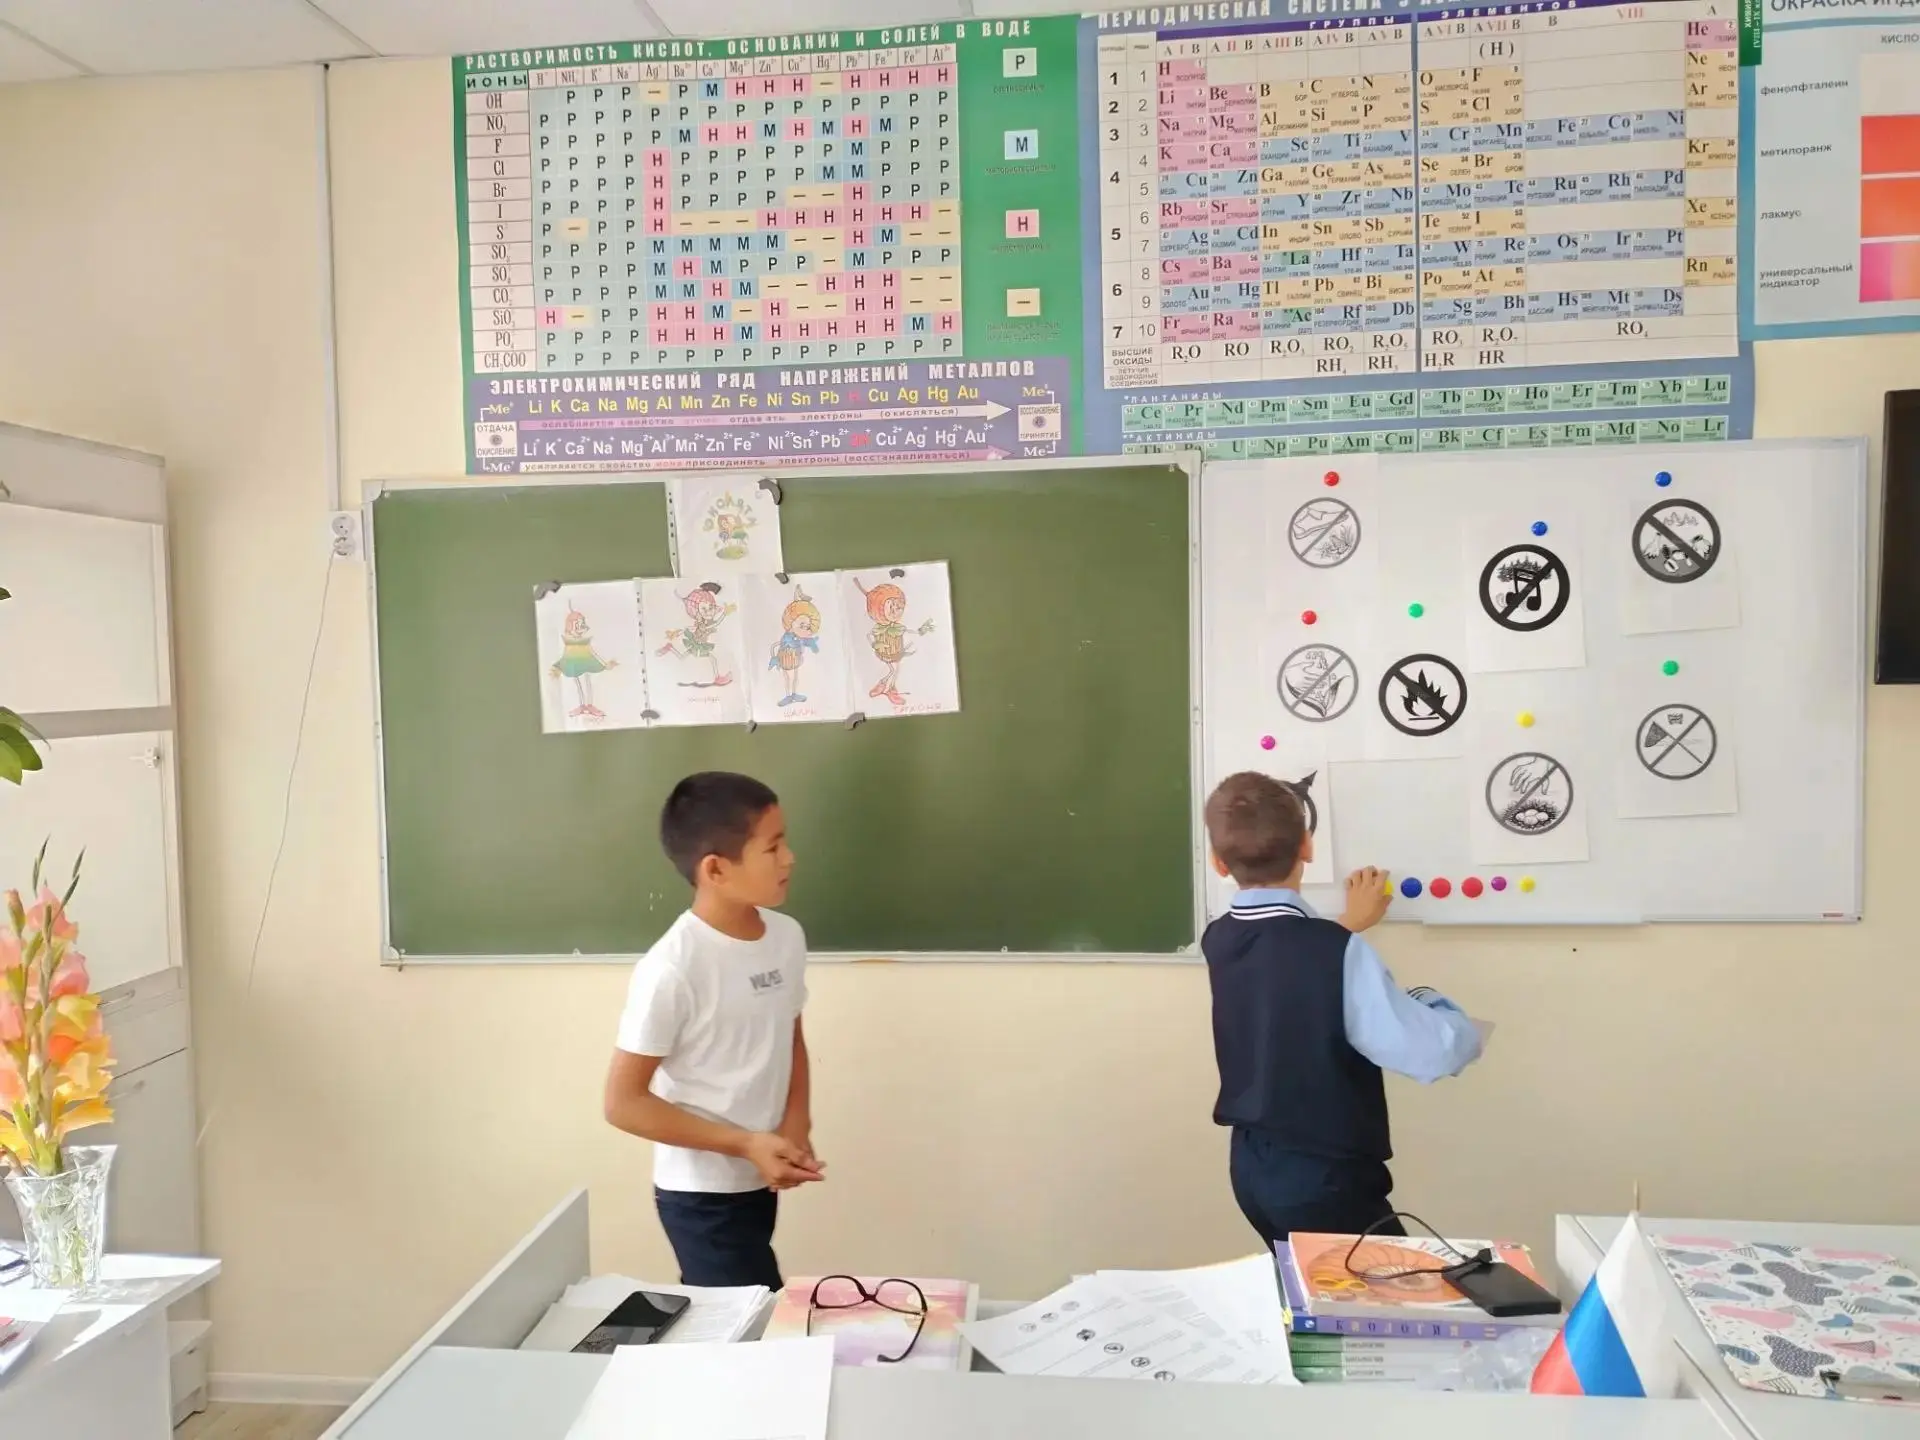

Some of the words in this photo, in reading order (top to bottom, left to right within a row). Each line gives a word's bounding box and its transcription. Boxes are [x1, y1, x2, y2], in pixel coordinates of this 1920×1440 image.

[1099, 0, 1270, 28] ПЕРИОДИЧЕСКАЯ
[1441, 1, 1576, 19] ЭЛЕМЕНТОВ
[1309, 16, 1395, 29] ГРУППЫ
[1687, 22, 1709, 36] He
[466, 45, 617, 69] РАСТВОРИМОСТЬ
[728, 30, 839, 55] ОСНОВАНИЙ
[856, 32, 864, 46] И
[881, 22, 939, 44] СОЛЕЙ
[956, 23, 965, 38] В
[982, 19, 1030, 38] ВОДЕ
[1160, 61, 1170, 75] H
[1109, 72, 1118, 85] 1
[1160, 91, 1174, 104] Li
[1210, 87, 1228, 100] Be
[1261, 83, 1271, 97] B
[1311, 79, 1323, 93] C
[1362, 75, 1374, 89] N
[1421, 72, 1433, 85] O
[1472, 68, 1483, 82] F
[1688, 51, 1708, 65] Ne
[1761, 80, 1848, 96] фенолфталеин
[1108, 101, 1119, 113] 2
[1160, 119, 1180, 131] Na
[1211, 115, 1234, 130] Mg
[1261, 112, 1277, 125] Al
[1312, 108, 1325, 121] Si
[1364, 104, 1373, 117] P
[1421, 101, 1430, 114] S
[1472, 97, 1490, 111] Cl
[1688, 82, 1708, 96] Ar
[1109, 128, 1119, 141] 3
[1161, 146, 1172, 160] K
[1210, 143, 1230, 157] Ca
[1291, 137, 1309, 151] Sc
[1344, 133, 1360, 147] Ti
[1400, 129, 1411, 142] V
[1449, 127, 1469, 141] Cr
[1496, 124, 1522, 137] Mn
[1558, 119, 1576, 133] Fe
[1608, 115, 1631, 129] Co
[1668, 111, 1684, 124] Ni
[1761, 144, 1832, 157] метилоранж
[1186, 173, 1207, 187] Cu
[1237, 170, 1258, 183] Zn
[1261, 168, 1282, 182] Ga
[1312, 164, 1334, 178] Ge
[1364, 161, 1383, 175] As
[1421, 158, 1439, 171] Se
[1474, 154, 1493, 167] Br
[1688, 139, 1709, 153] Kr
[1110, 171, 1120, 183] 4
[1162, 202, 1182, 217] Rb
[1211, 200, 1228, 213] Sr
[1298, 194, 1309, 207] Y
[1342, 190, 1361, 204] Zr
[1392, 187, 1413, 201] Nb
[1446, 183, 1471, 198] Mo
[1505, 179, 1524, 194] Tc
[1555, 176, 1577, 191] Ru
[1608, 173, 1631, 187] Rh
[1664, 170, 1684, 185] Pd
[1760, 209, 1801, 219] лакмус
[1188, 231, 1208, 245] Ag
[1237, 226, 1258, 240] Cd
[1263, 225, 1278, 238] In
[1313, 221, 1332, 235] Sn
[1365, 218, 1384, 232] Sb
[1422, 214, 1440, 228] Te
[1687, 199, 1707, 213] Xe
[1111, 228, 1121, 240] 5
[1162, 260, 1181, 273] Cs
[1213, 256, 1232, 269] Ba
[1342, 248, 1362, 261] Hf
[1395, 244, 1413, 258] Ta
[1454, 241, 1471, 254] W
[1504, 237, 1525, 251] Re
[1557, 234, 1578, 249] Os
[1617, 231, 1631, 245] Ir
[1667, 229, 1683, 243] Pt
[1760, 261, 1853, 279] универсальный
[1188, 287, 1209, 300] Au
[1238, 282, 1260, 298] Hg
[1263, 281, 1278, 294] Tl
[1315, 278, 1334, 291] Pb
[1366, 275, 1382, 289] Bi
[1423, 272, 1442, 286] Po
[1475, 269, 1494, 282] At
[1687, 258, 1708, 272] Rn
[1760, 278, 1820, 289] индикатор
[1112, 283, 1122, 296] 6
[1163, 316, 1180, 330] Fr
[1213, 313, 1233, 326] Ra
[1343, 305, 1362, 319] Rf
[1393, 302, 1414, 316] Db
[1453, 299, 1472, 316] Sg
[1504, 295, 1525, 310] Bh
[1558, 292, 1578, 307] Hs
[1608, 291, 1629, 304] Mt
[1664, 289, 1682, 302] Ds
[1112, 326, 1123, 339] 7
[1112, 348, 1153, 357] ВЫСШИЕ
[1113, 357, 1152, 365] ОКСИДЫ
[490, 371, 701, 395] ЭЛЕКТРОХИМИЧЕСКИЙ
[718, 372, 755, 389] РЯД
[780, 363, 908, 386] НАПРЯЖЕНИЙ
[929, 360, 1035, 380] МЕТАЛЛОВ
[1704, 377, 1726, 392] Lu
[529, 400, 542, 414] Li
[551, 400, 561, 412] K
[571, 399, 589, 412] Ca
[598, 398, 618, 411] Na
[626, 397, 648, 414] Mg
[657, 396, 672, 410] Al
[681, 395, 703, 409] Mn
[712, 395, 731, 408] Zn
[739, 394, 758, 407] Fe
[768, 393, 783, 406] Ni
[791, 392, 811, 405] Sn
[821, 391, 839, 404] Pb
[868, 389, 888, 402] Cu
[897, 388, 918, 404] Ag
[928, 387, 948, 403] Hg
[957, 385, 978, 399] Au
[477, 424, 514, 432] ОТДАЧА
